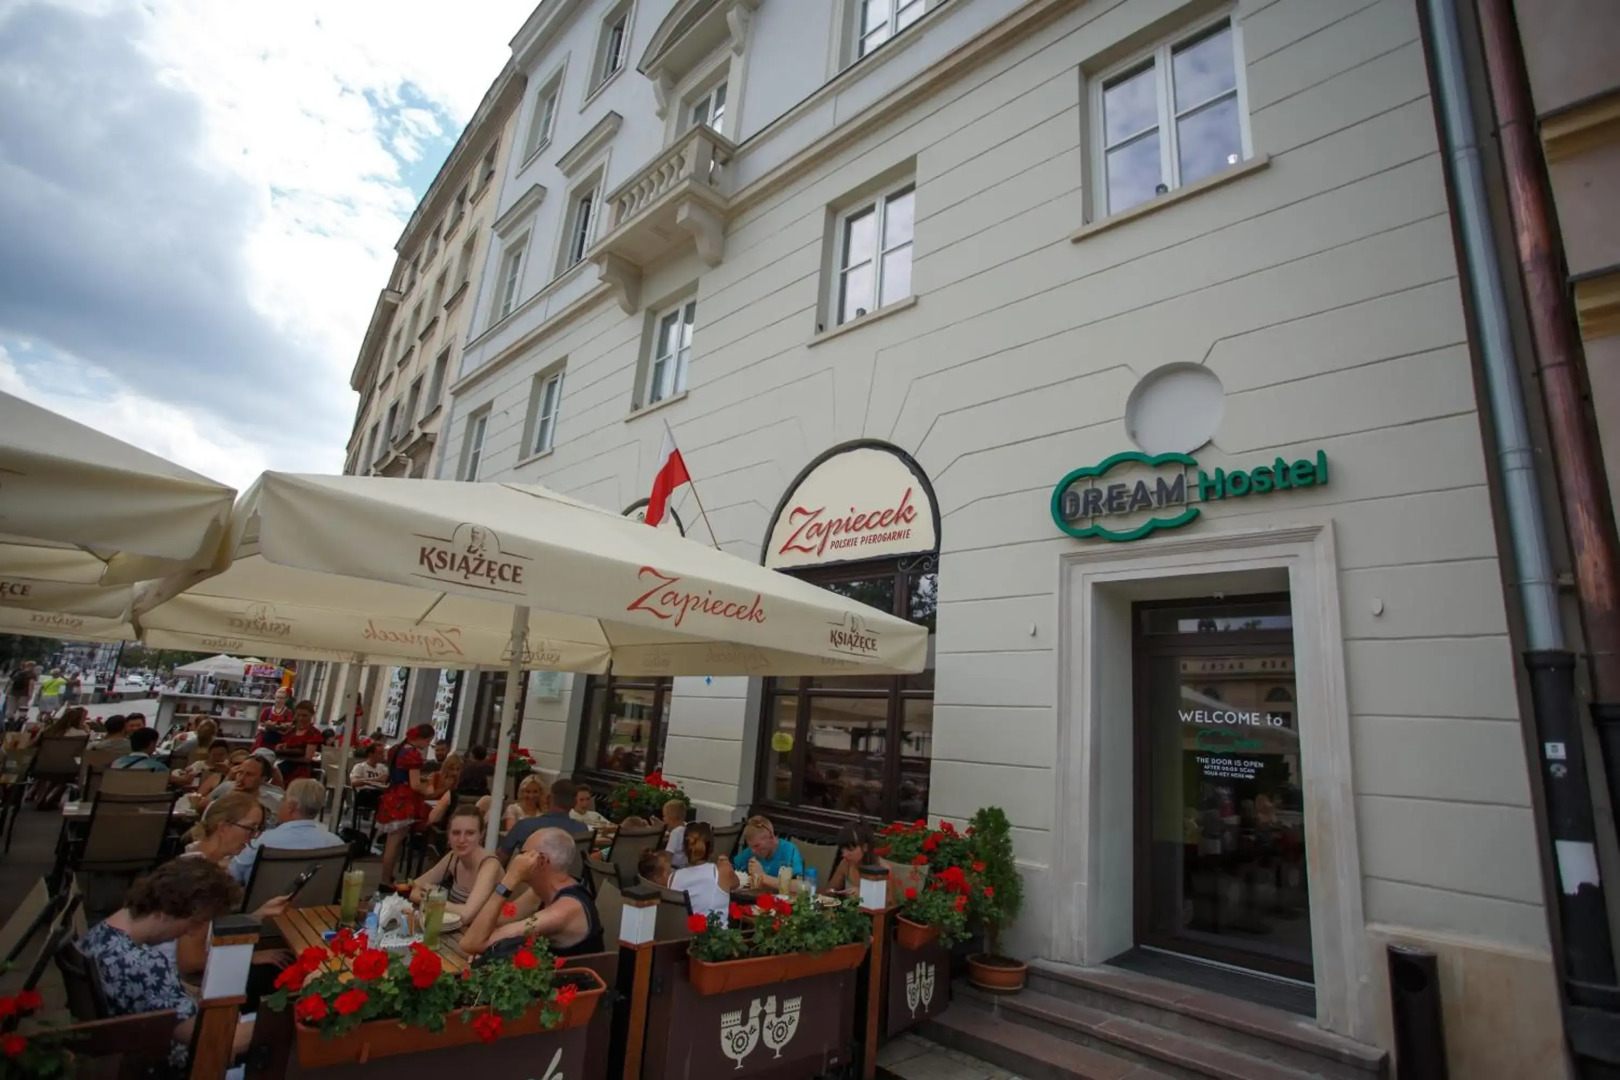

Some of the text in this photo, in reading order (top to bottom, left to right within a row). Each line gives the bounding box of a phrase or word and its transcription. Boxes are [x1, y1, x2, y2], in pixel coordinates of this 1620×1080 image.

[1061, 449, 1328, 521] DREAM Hostel
[779, 487, 918, 557] Zapiecek
[830, 529, 912, 550] POLSKIE PIEROGARNIE
[419, 546, 523, 585] KSIĄŻĘCE
[627, 566, 767, 628] Zapiecek
[830, 630, 878, 653] KSIĄŻĘCE
[1178, 709, 1283, 726] WELCOME to
[1196, 756, 1209, 764] THE
[1211, 757, 1232, 766] DOOR
[1243, 760, 1264, 768] OPEN
